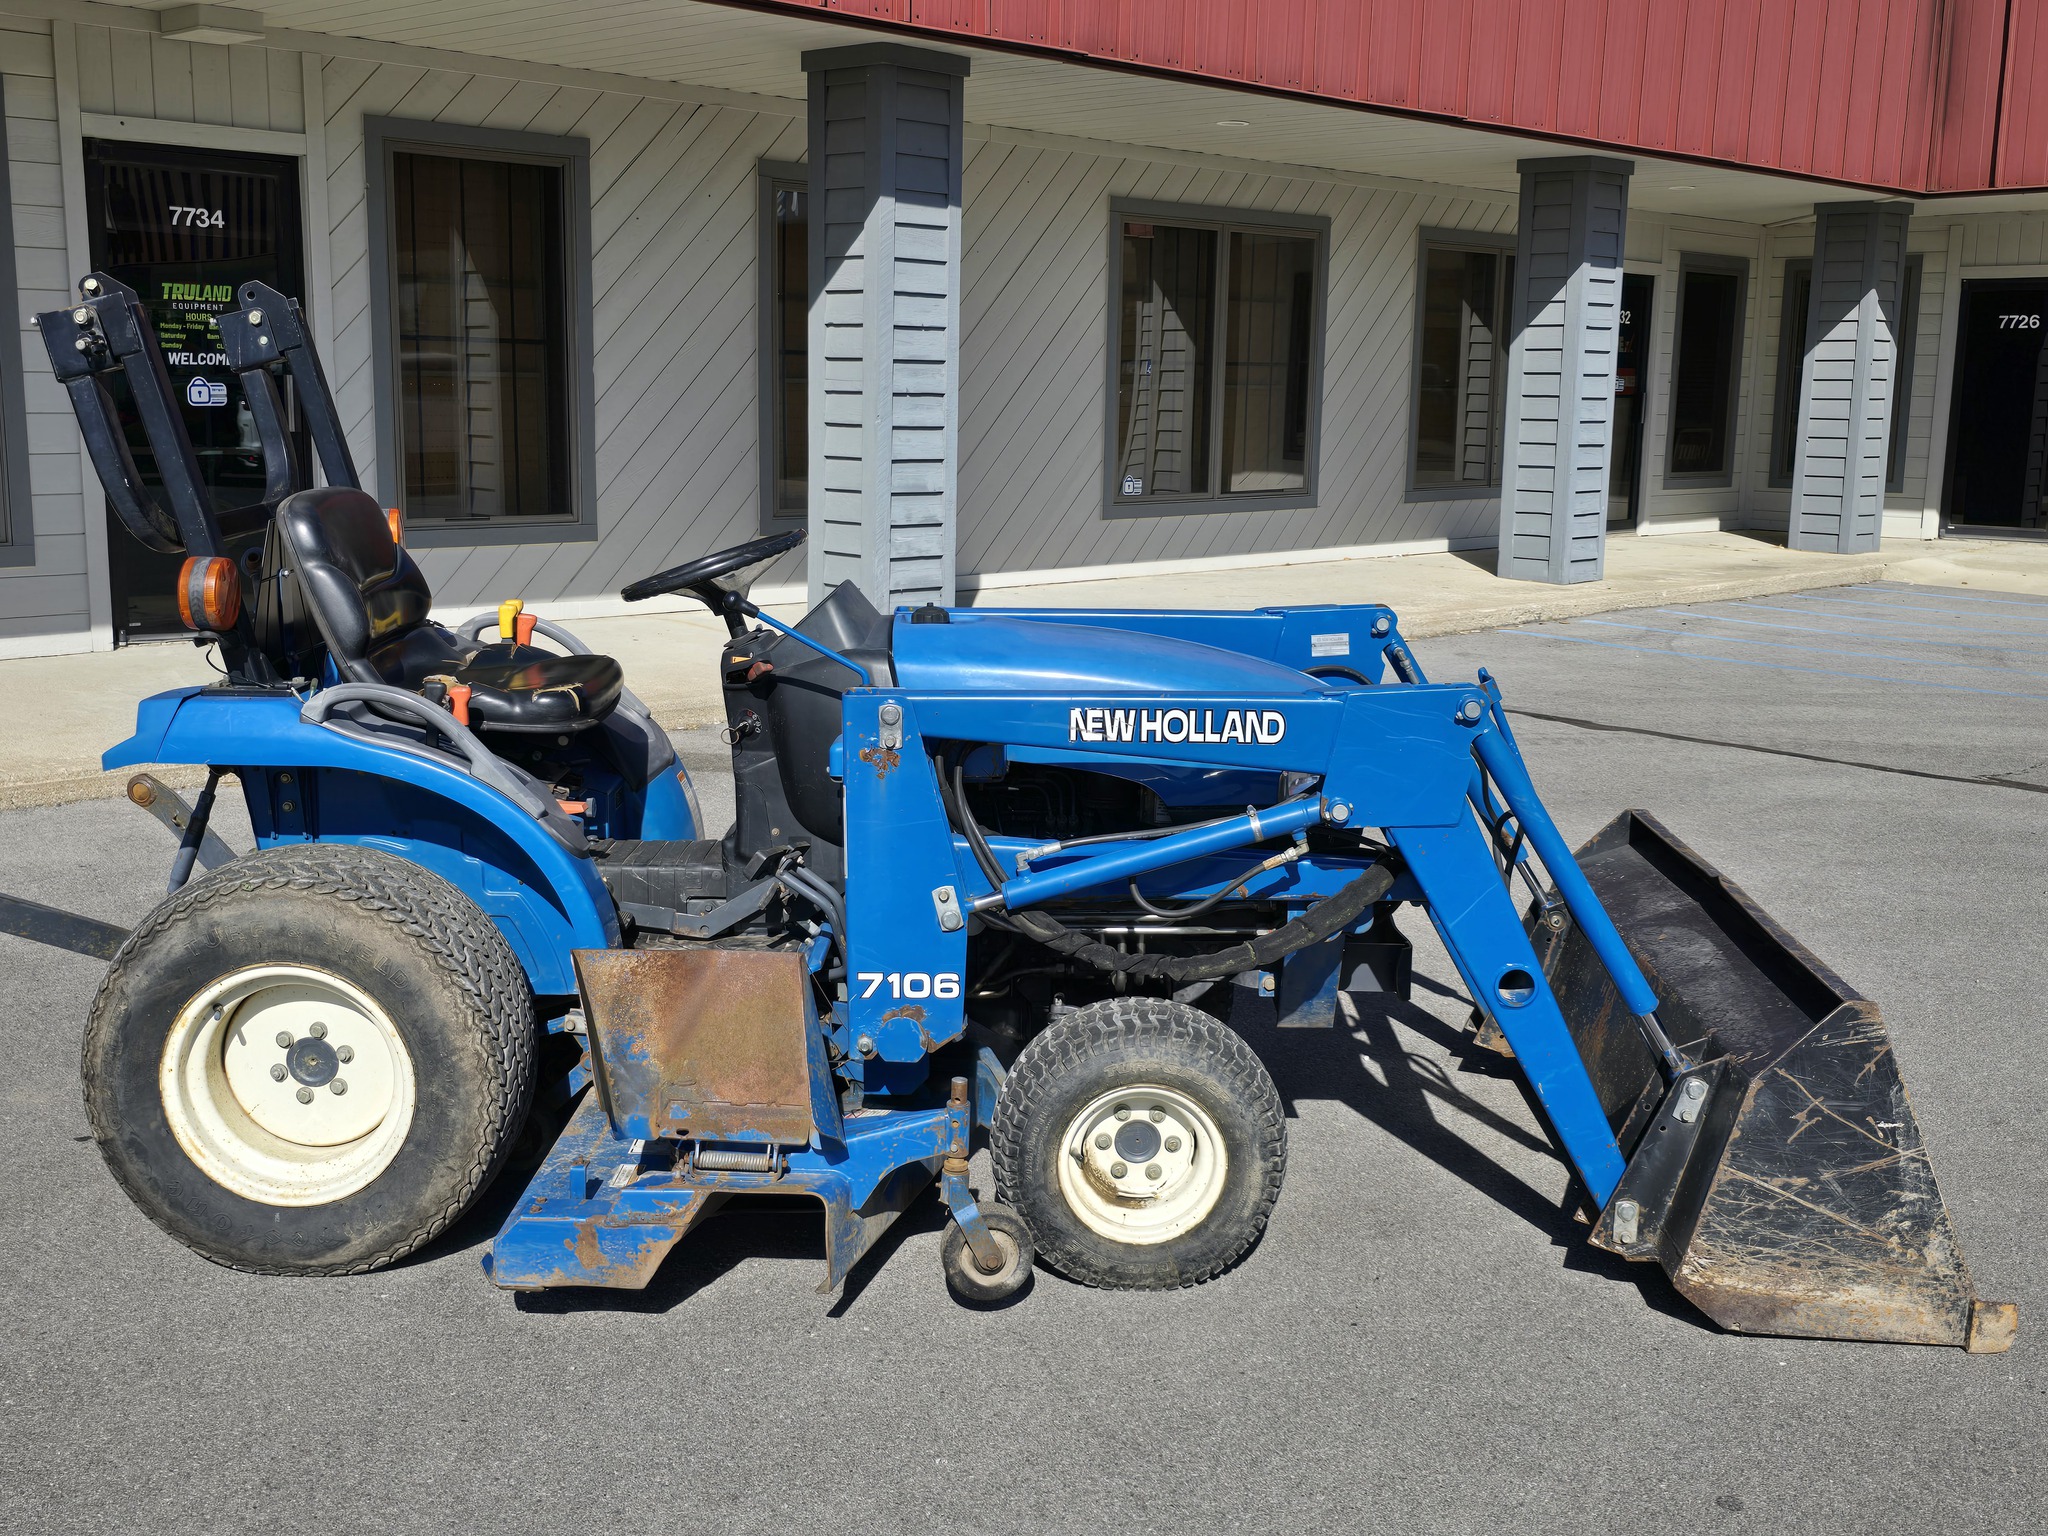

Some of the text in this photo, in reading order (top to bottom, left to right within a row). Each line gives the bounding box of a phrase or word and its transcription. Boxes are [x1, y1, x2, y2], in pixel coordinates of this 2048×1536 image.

[169, 206, 225, 228] 7734
[161, 282, 232, 302] TRULAND
[172, 302, 224, 311] EQUIPMENT
[185, 312, 212, 321] HOURS
[1999, 314, 2040, 329] 7726
[160, 322, 182, 330] Monday
[186, 323, 205, 331] Friday
[160, 332, 187, 340] Saturday
[168, 352, 231, 366] WELCOM
[1069, 707, 1286, 745] NEW HOLLAND
[857, 971, 960, 999] 7106
